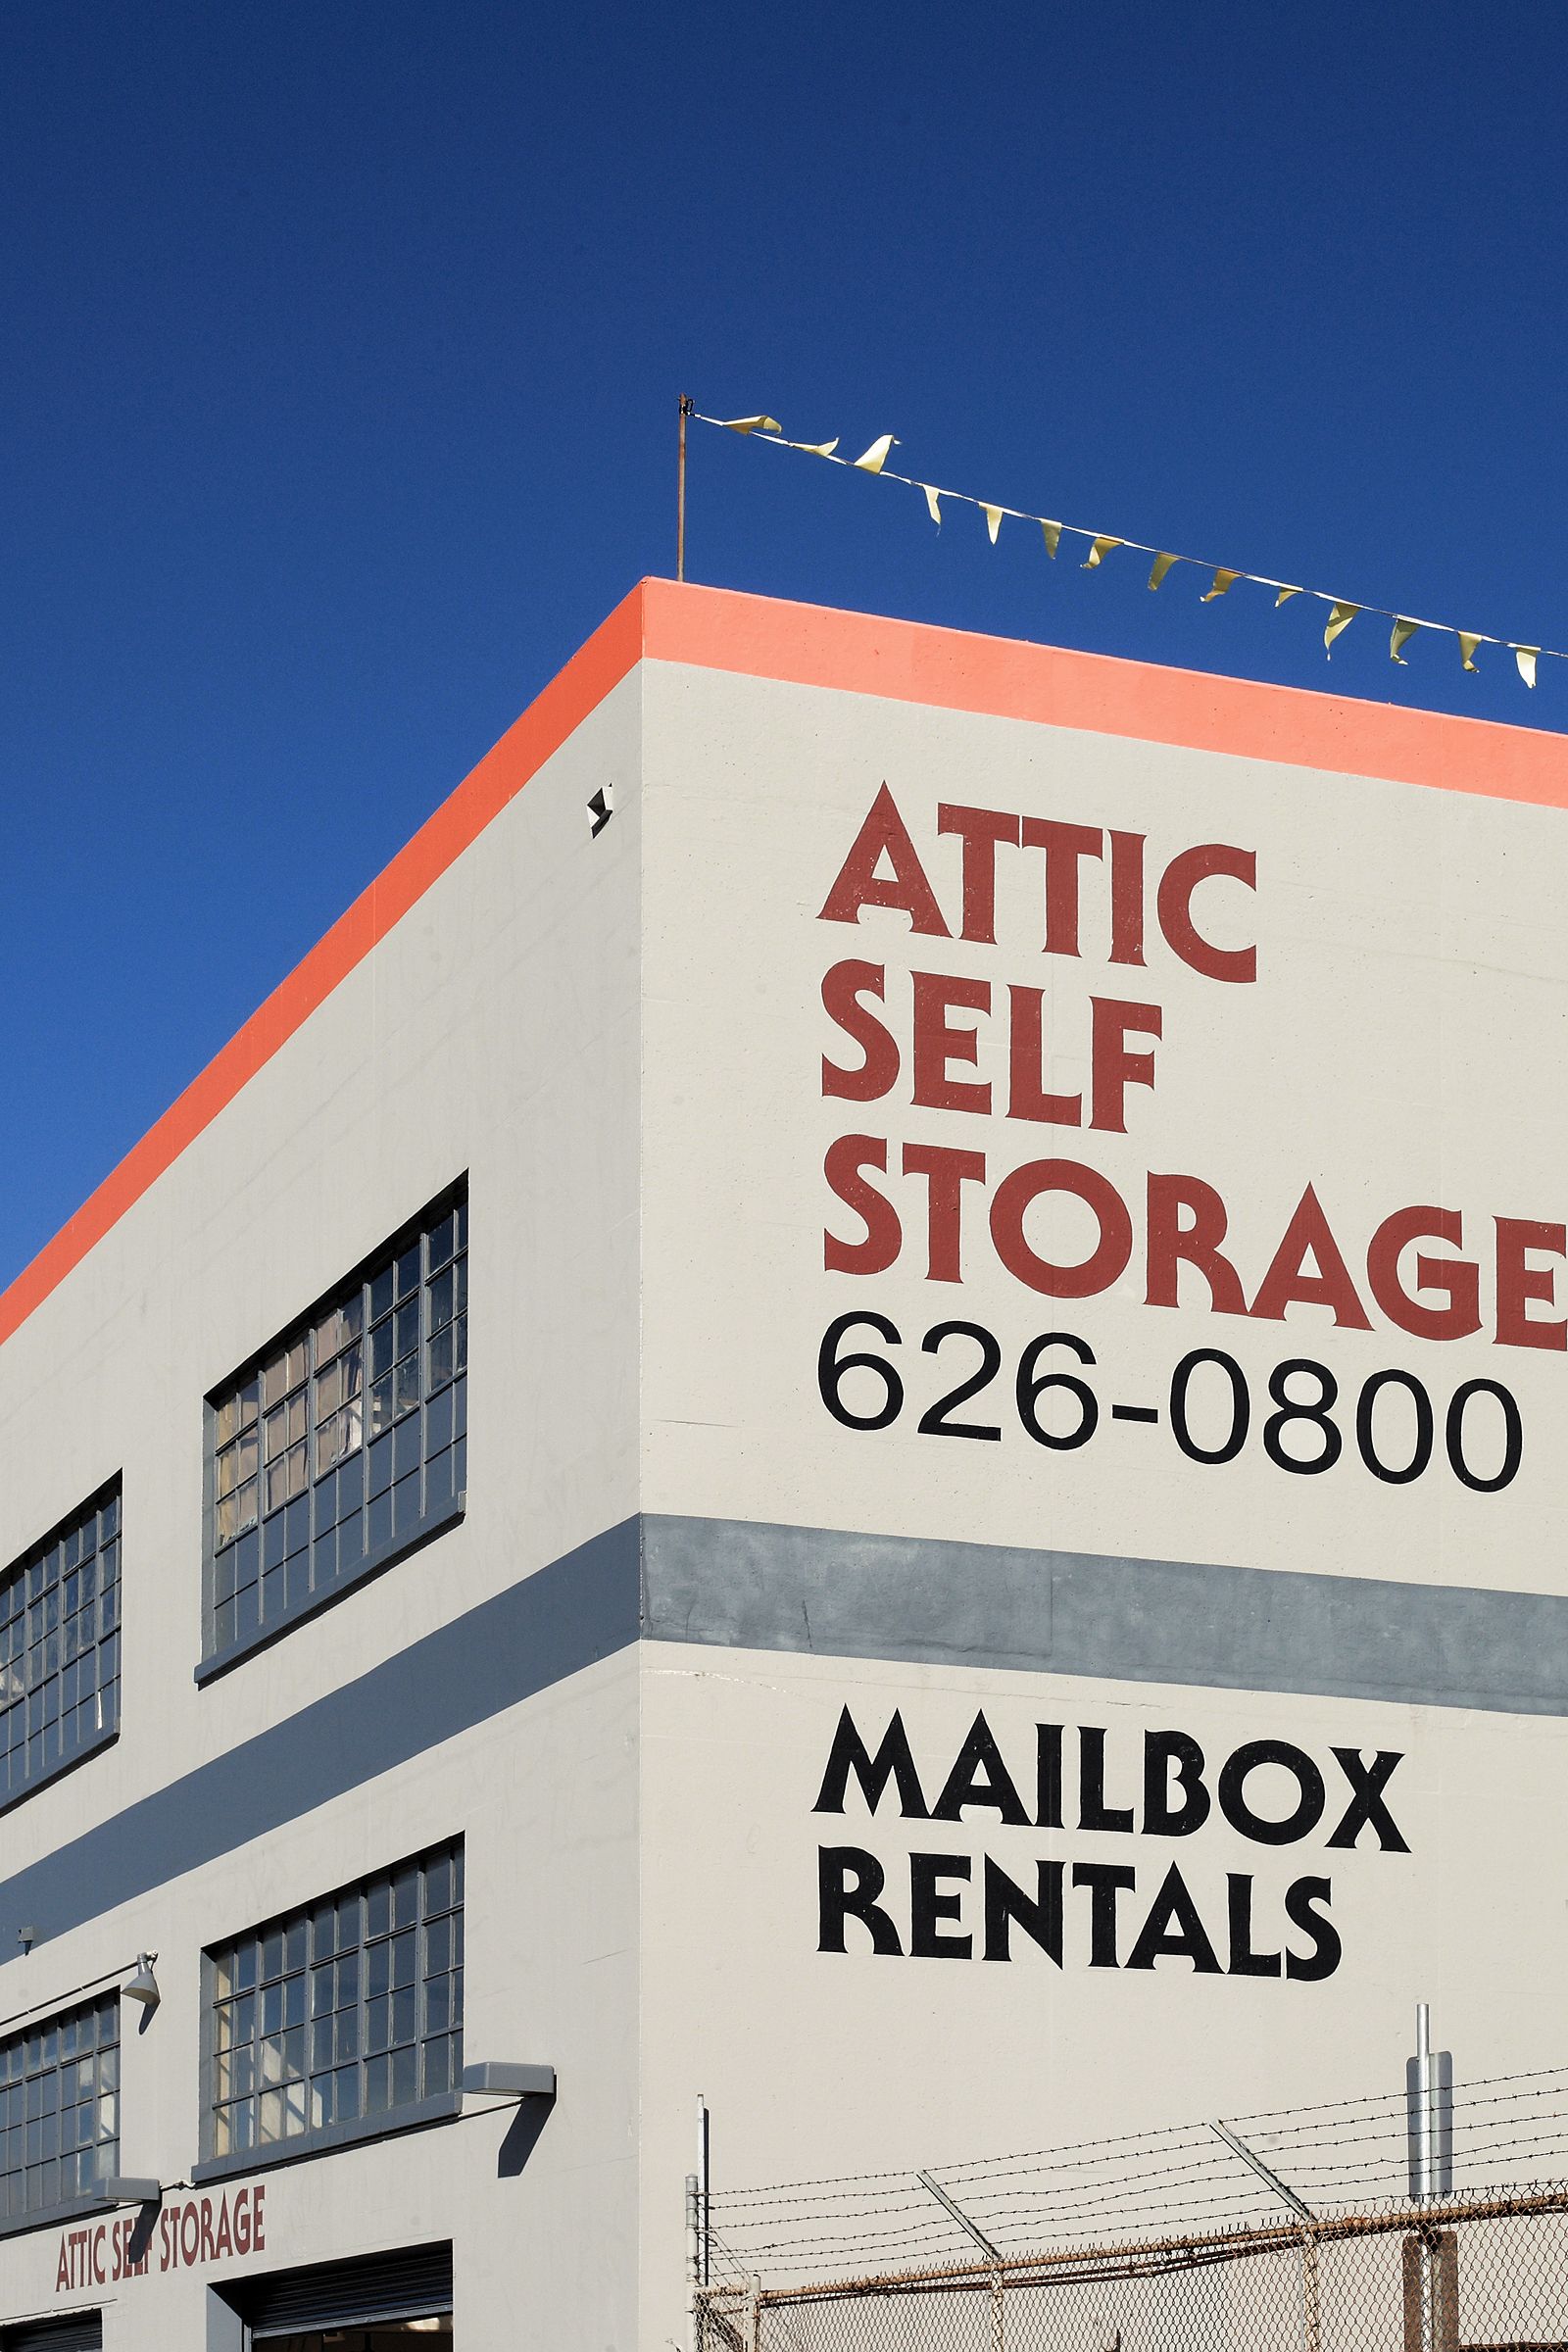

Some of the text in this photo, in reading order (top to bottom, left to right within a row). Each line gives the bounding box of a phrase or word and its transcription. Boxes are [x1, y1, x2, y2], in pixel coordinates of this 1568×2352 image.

[814, 780, 1257, 983] ATTIC
[820, 958, 1163, 1134] SELF
[822, 1133, 1568, 1352] STORAGE
[816, 1310, 1524, 1494] 626-0800
[810, 1703, 1412, 1854] MAILBOX
[815, 1844, 1343, 1983] RENTALS
[55, 2225, 106, 2292] ATTIC
[160, 2184, 266, 2272] STORAGE
